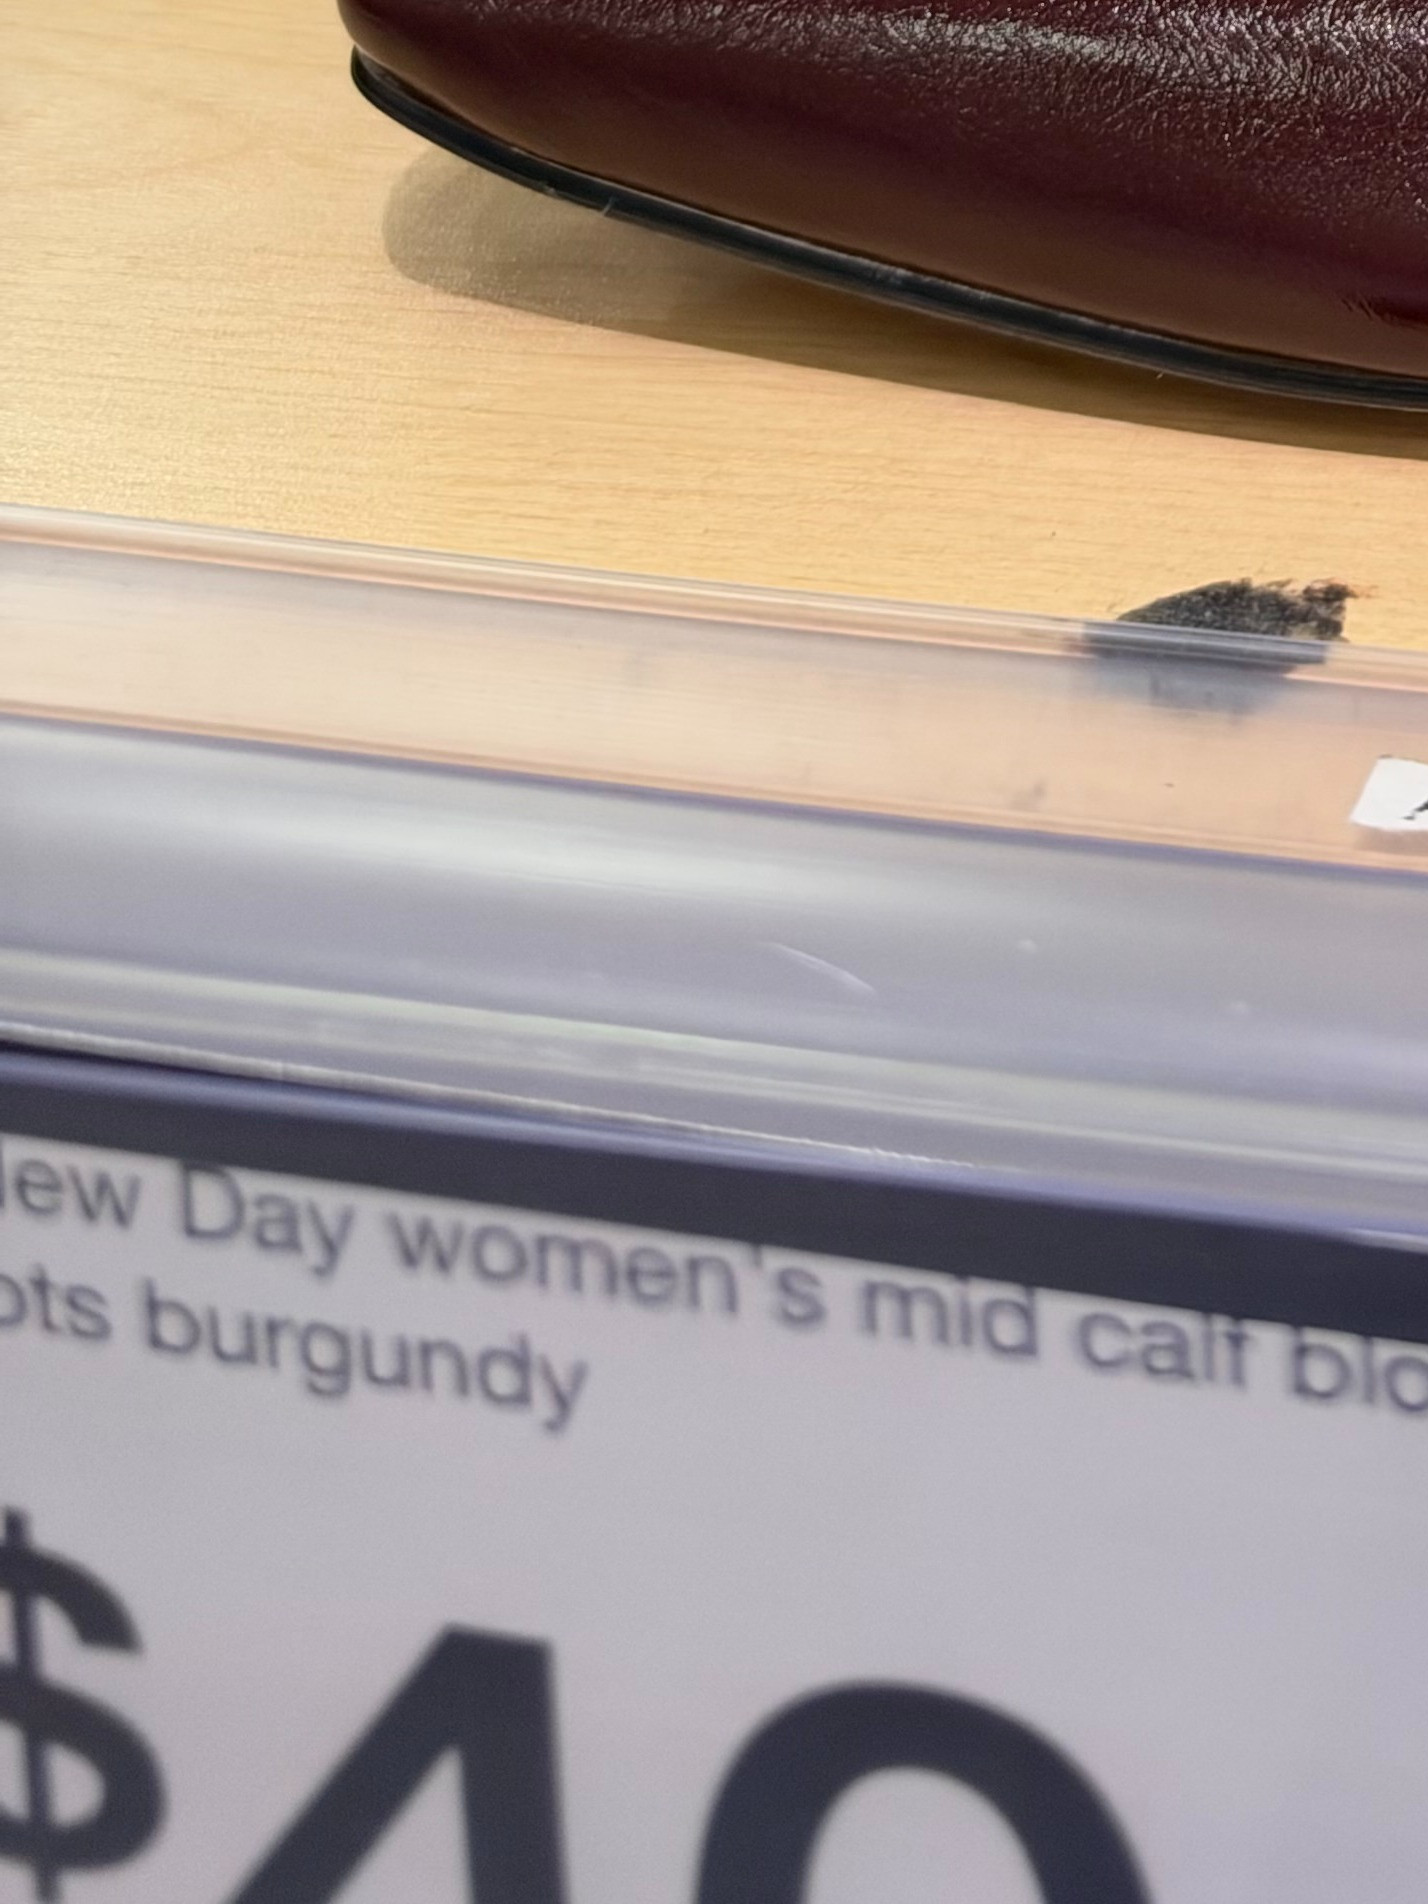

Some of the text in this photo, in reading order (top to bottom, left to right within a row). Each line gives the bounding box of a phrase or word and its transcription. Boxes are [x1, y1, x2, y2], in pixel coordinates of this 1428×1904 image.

[0, 1147, 143, 1230] ew
[178, 1158, 354, 1280] Day
[385, 1210, 826, 1328] women's
[862, 1274, 1038, 1360] mid
[140, 1275, 588, 1433] burgundy
